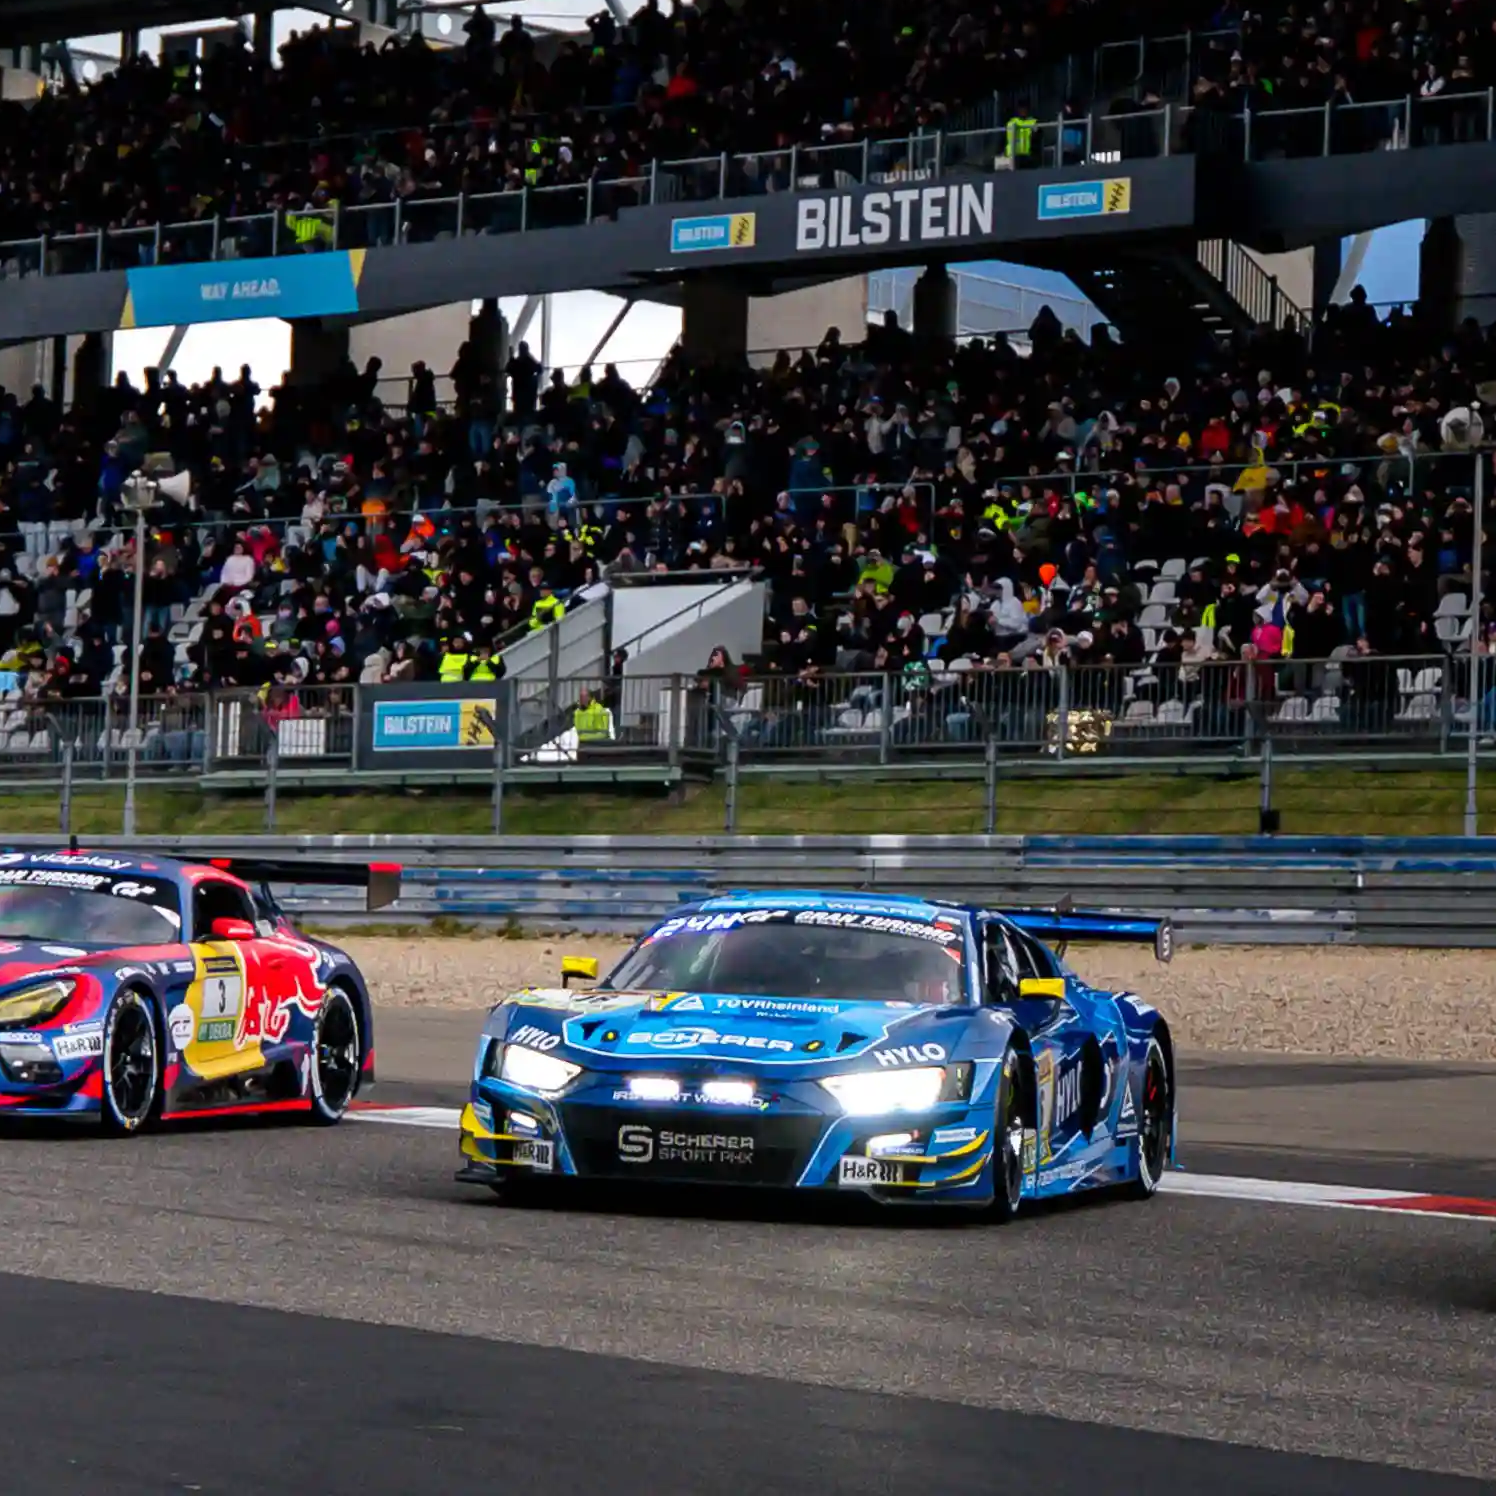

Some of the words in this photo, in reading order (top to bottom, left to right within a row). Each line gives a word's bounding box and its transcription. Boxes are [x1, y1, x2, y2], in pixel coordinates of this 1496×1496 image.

[795, 181, 994, 251] BILSTEIN
[201, 282, 228, 300] WAY
[383, 714, 452, 736] BILSTEIN
[30, 852, 132, 870] viaplay
[27, 870, 106, 887] TURISMO
[653, 912, 743, 939] 24H
[794, 910, 860, 924] GRAN
[862, 915, 957, 942] TURISMO
[217, 979, 226, 1014] 3
[511, 1024, 561, 1051] HYLO
[626, 1031, 794, 1053] SCHERER
[873, 1042, 946, 1067] HYLO
[843, 1161, 878, 1180] H&R
